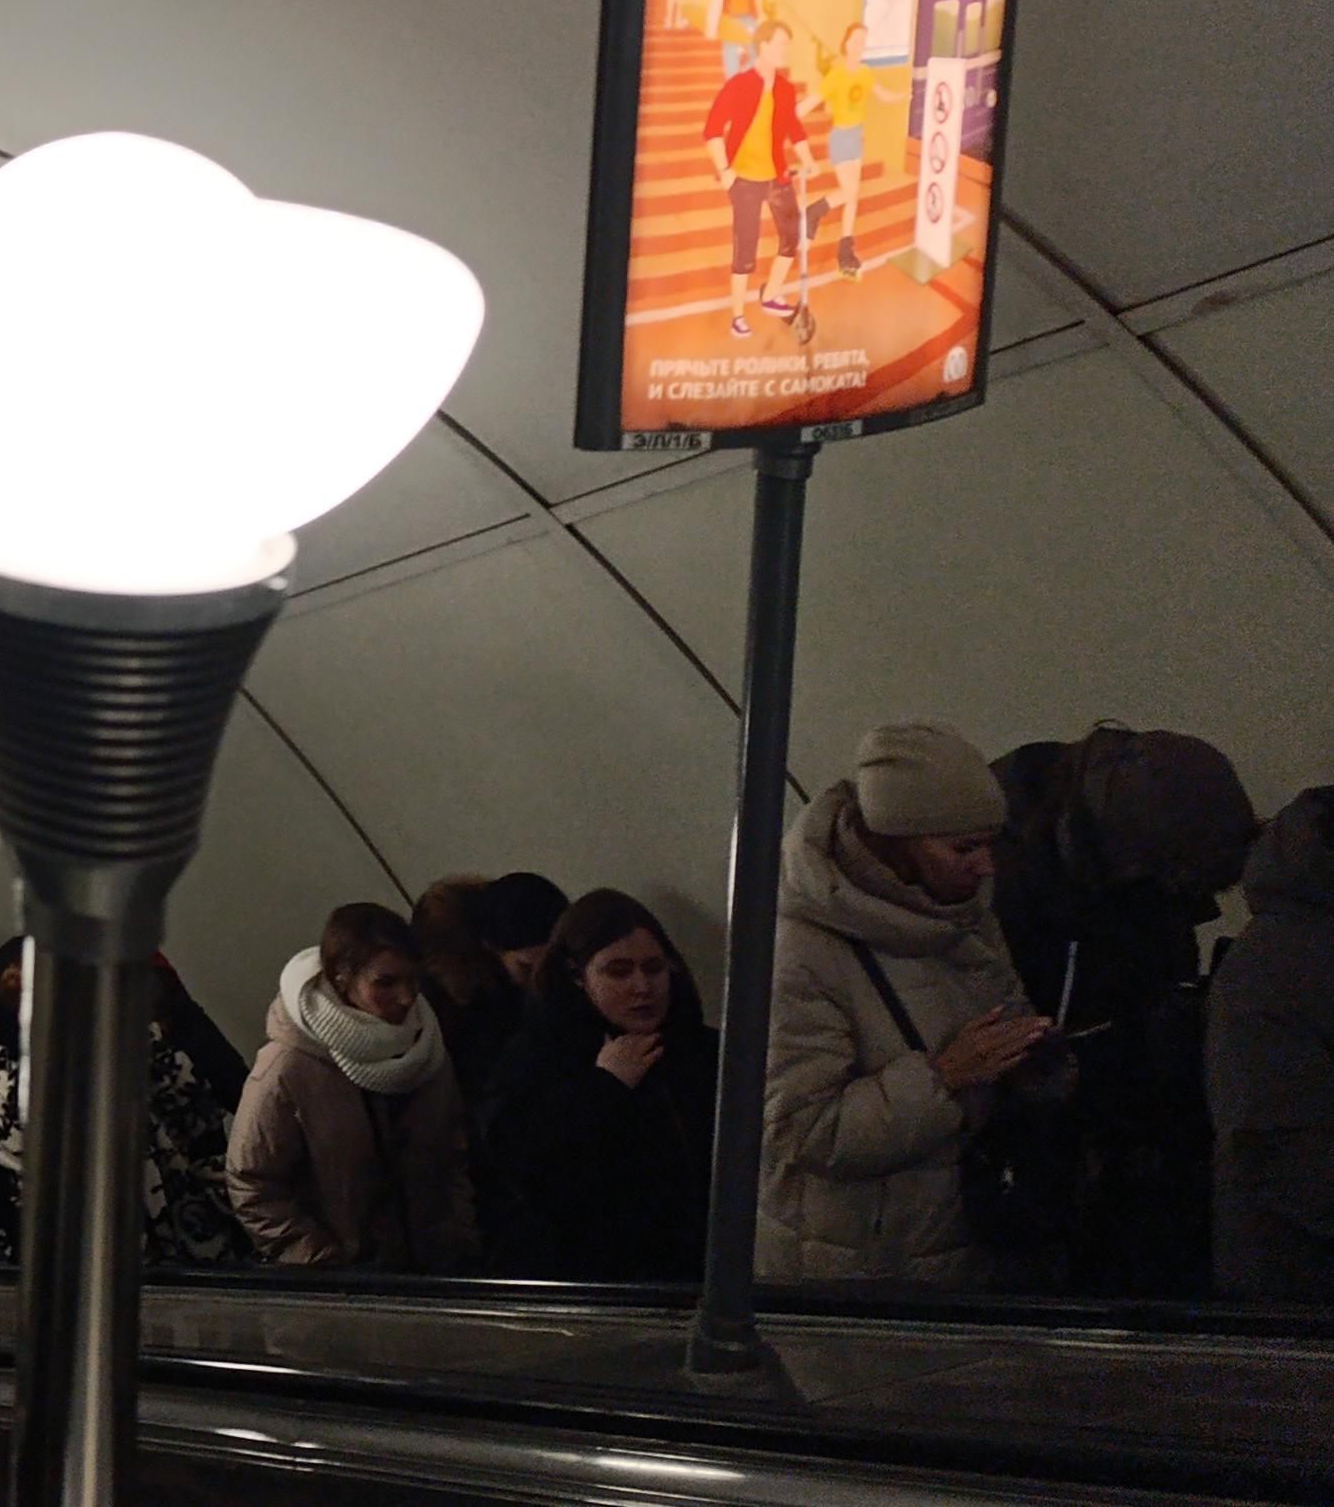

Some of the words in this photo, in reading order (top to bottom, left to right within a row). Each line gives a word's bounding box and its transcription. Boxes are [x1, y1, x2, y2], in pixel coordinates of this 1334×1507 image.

[650, 359, 730, 377] ПРЯЧЬТЕ
[813, 349, 870, 369] РЕБЯТА,
[648, 382, 663, 399] И
[667, 377, 758, 400] СЛЕЗАЙТЕ
[764, 379, 776, 397] С
[780, 371, 868, 396] САМОКАТА!
